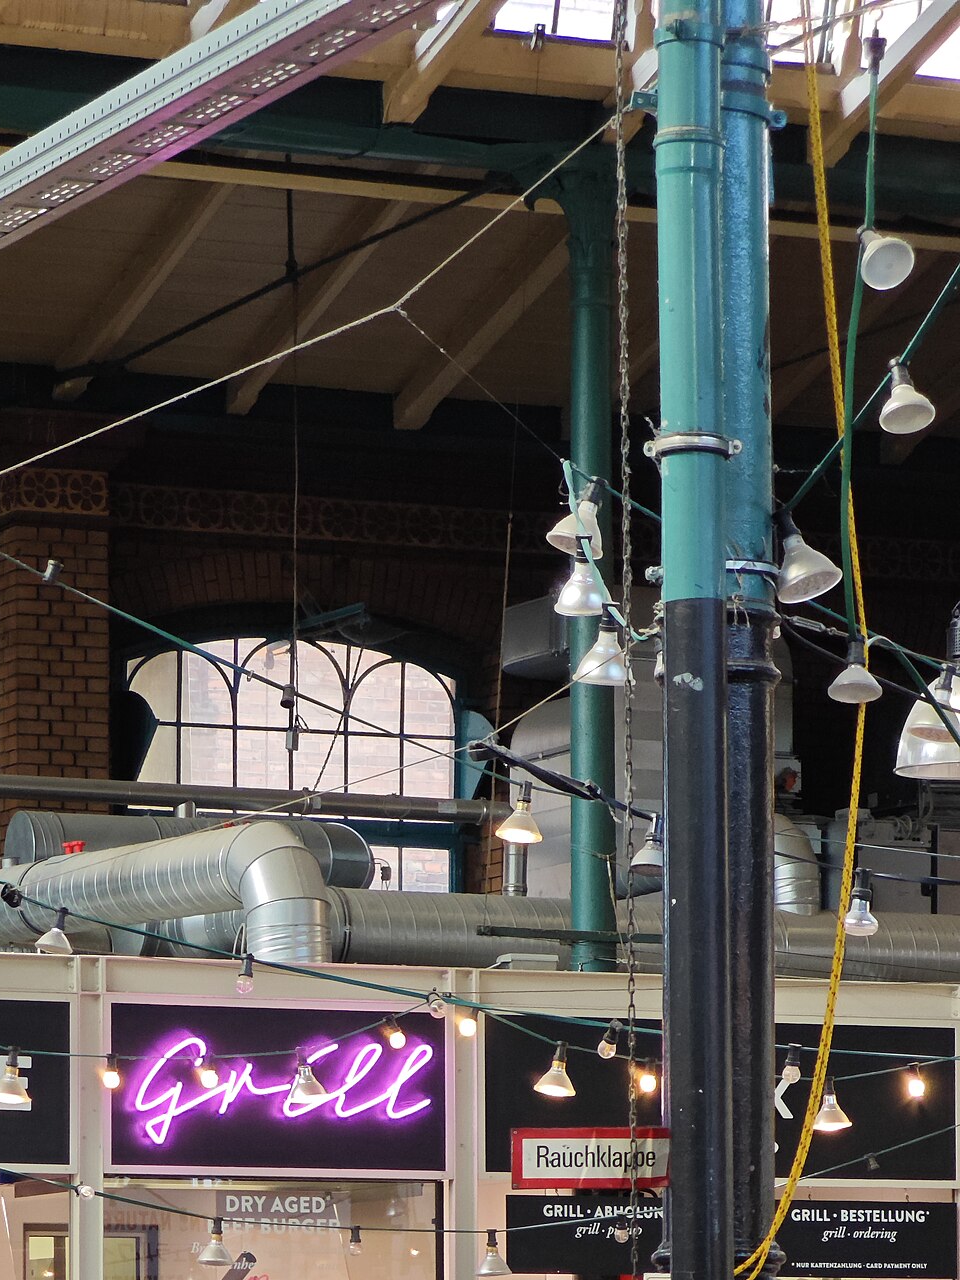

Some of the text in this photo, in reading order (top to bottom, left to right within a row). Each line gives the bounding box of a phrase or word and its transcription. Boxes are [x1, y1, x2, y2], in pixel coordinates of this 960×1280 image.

[135, 1037, 433, 1145] Grill
[536, 1144, 656, 1173] Rauchklappe
[226, 1195, 267, 1213] DRY
[543, 1204, 663, 1220] GRILL ABHOLUN
[791, 1209, 830, 1222] GRILL
[575, 1223, 599, 1239] grill
[822, 1226, 898, 1242] grill ordering
